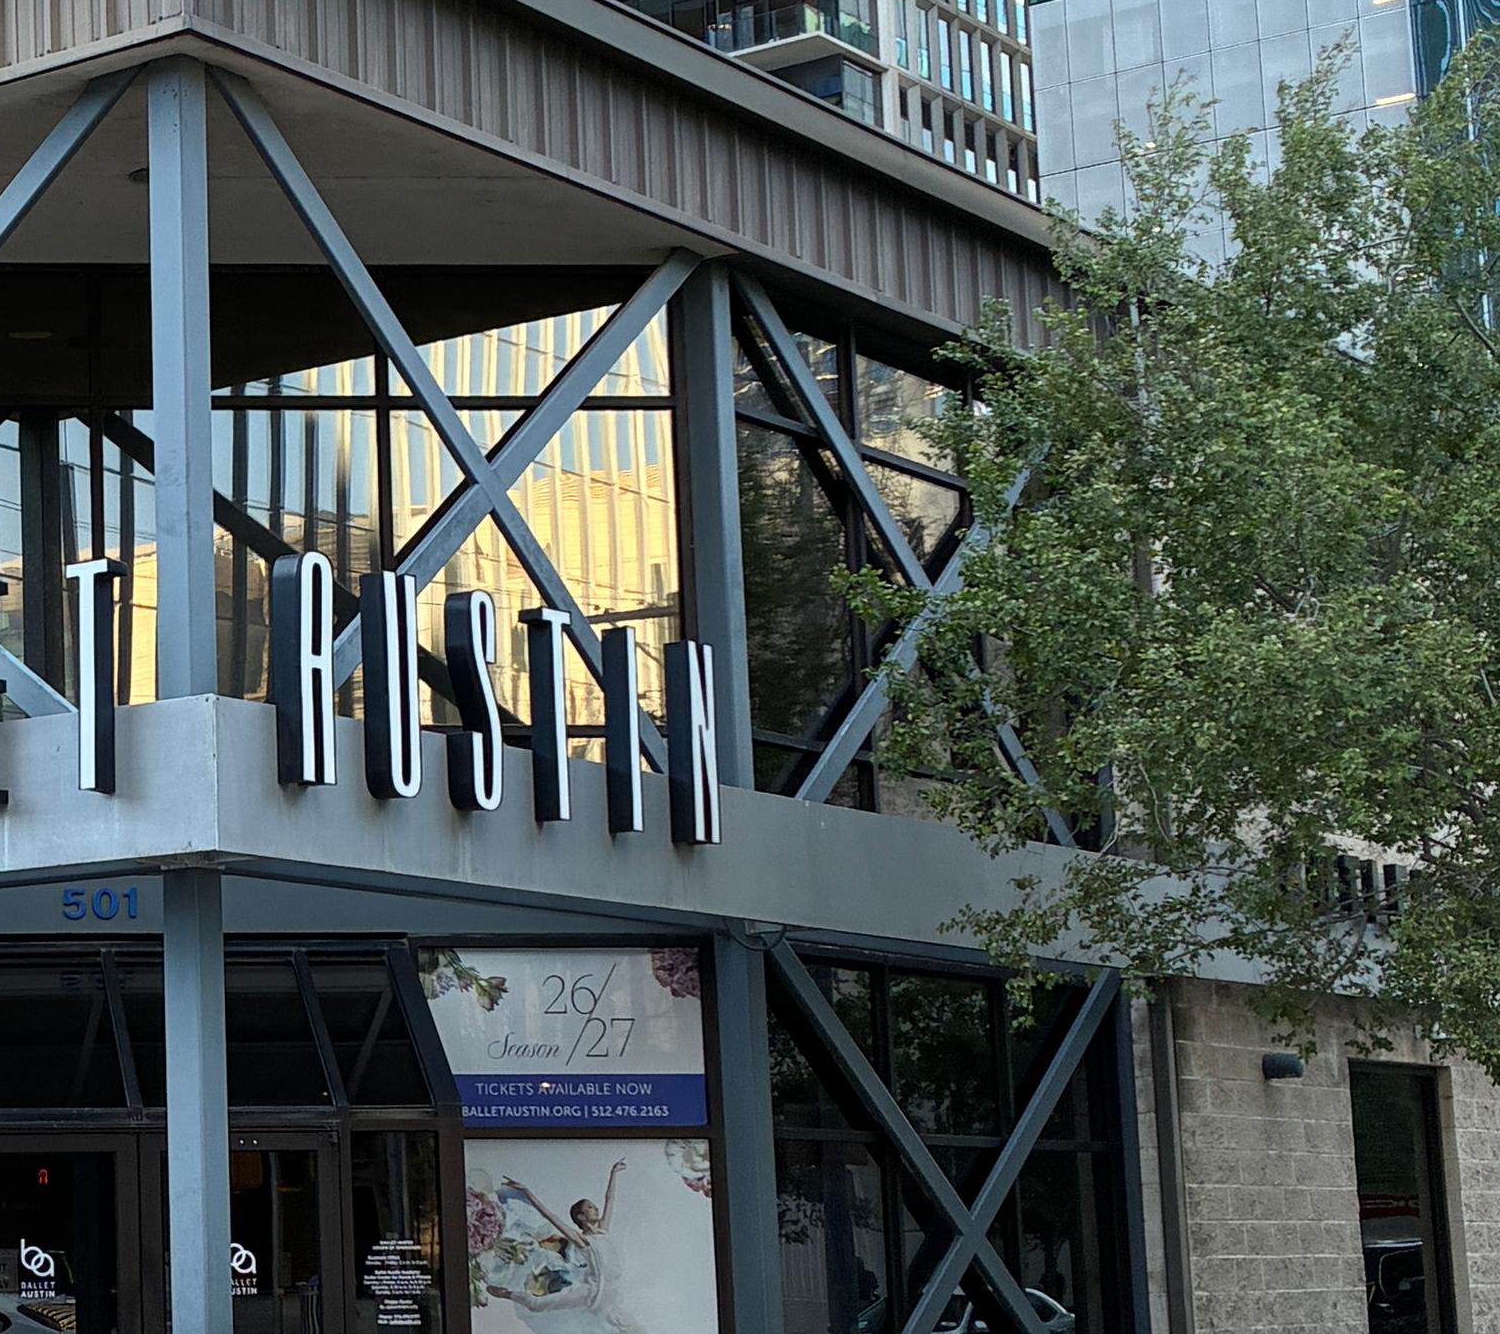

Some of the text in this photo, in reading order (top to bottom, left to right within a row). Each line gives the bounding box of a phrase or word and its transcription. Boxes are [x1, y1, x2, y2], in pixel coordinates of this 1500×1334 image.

[270, 550, 722, 845] AUSTIN
[62, 887, 139, 920] 501
[487, 1032, 561, 1061] Season
[476, 1082, 652, 1095] TICKETS AVAILABLE NOW
[462, 1106, 581, 1117] BALLETAUSTIN.ORG
[592, 1106, 669, 1117] 512.476.2163
[21, 1281, 56, 1290] BALLET
[20, 1289, 56, 1298] AUSTIN
